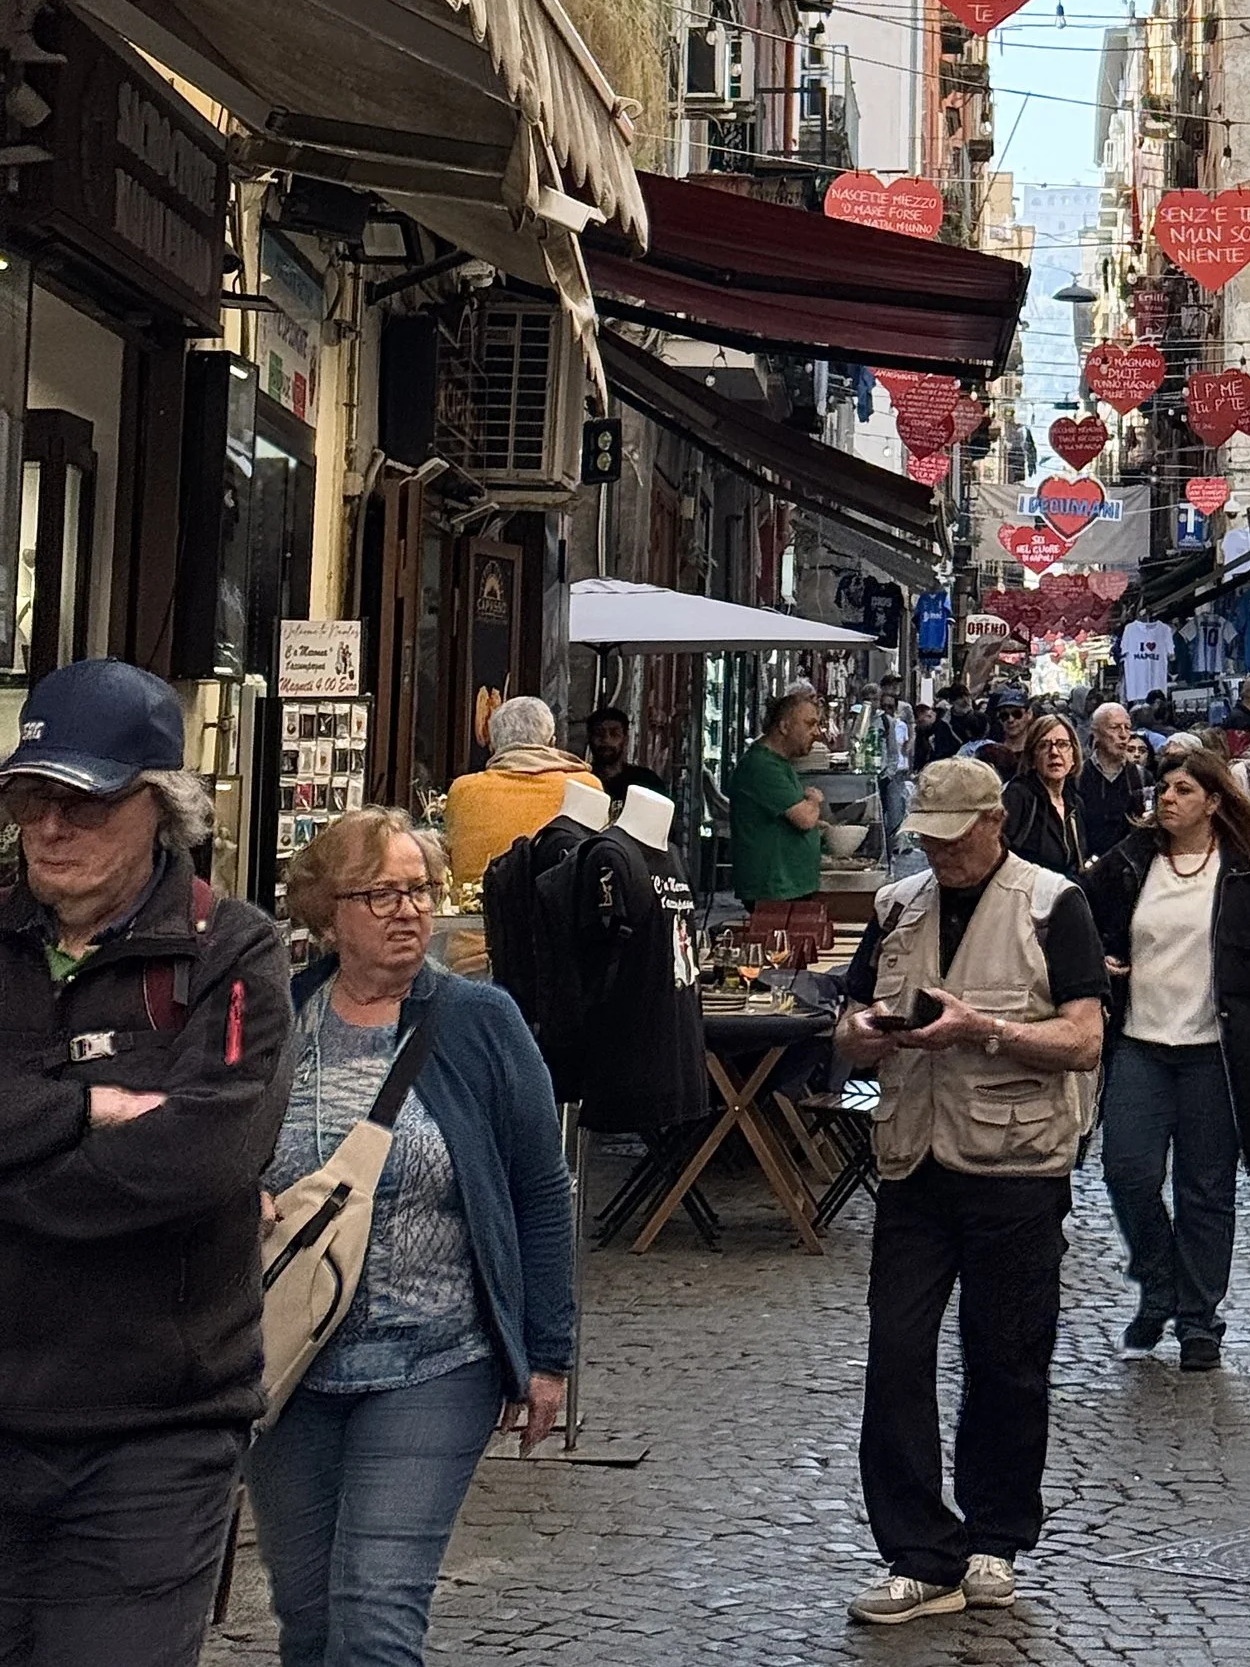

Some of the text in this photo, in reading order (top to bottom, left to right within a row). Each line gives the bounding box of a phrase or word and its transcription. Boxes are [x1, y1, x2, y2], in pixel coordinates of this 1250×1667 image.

[967, 4, 993, 23] TE
[1170, 226, 1221, 244] NUN
[1177, 245, 1245, 263] NIENTE
[1220, 379, 1243, 396] ME
